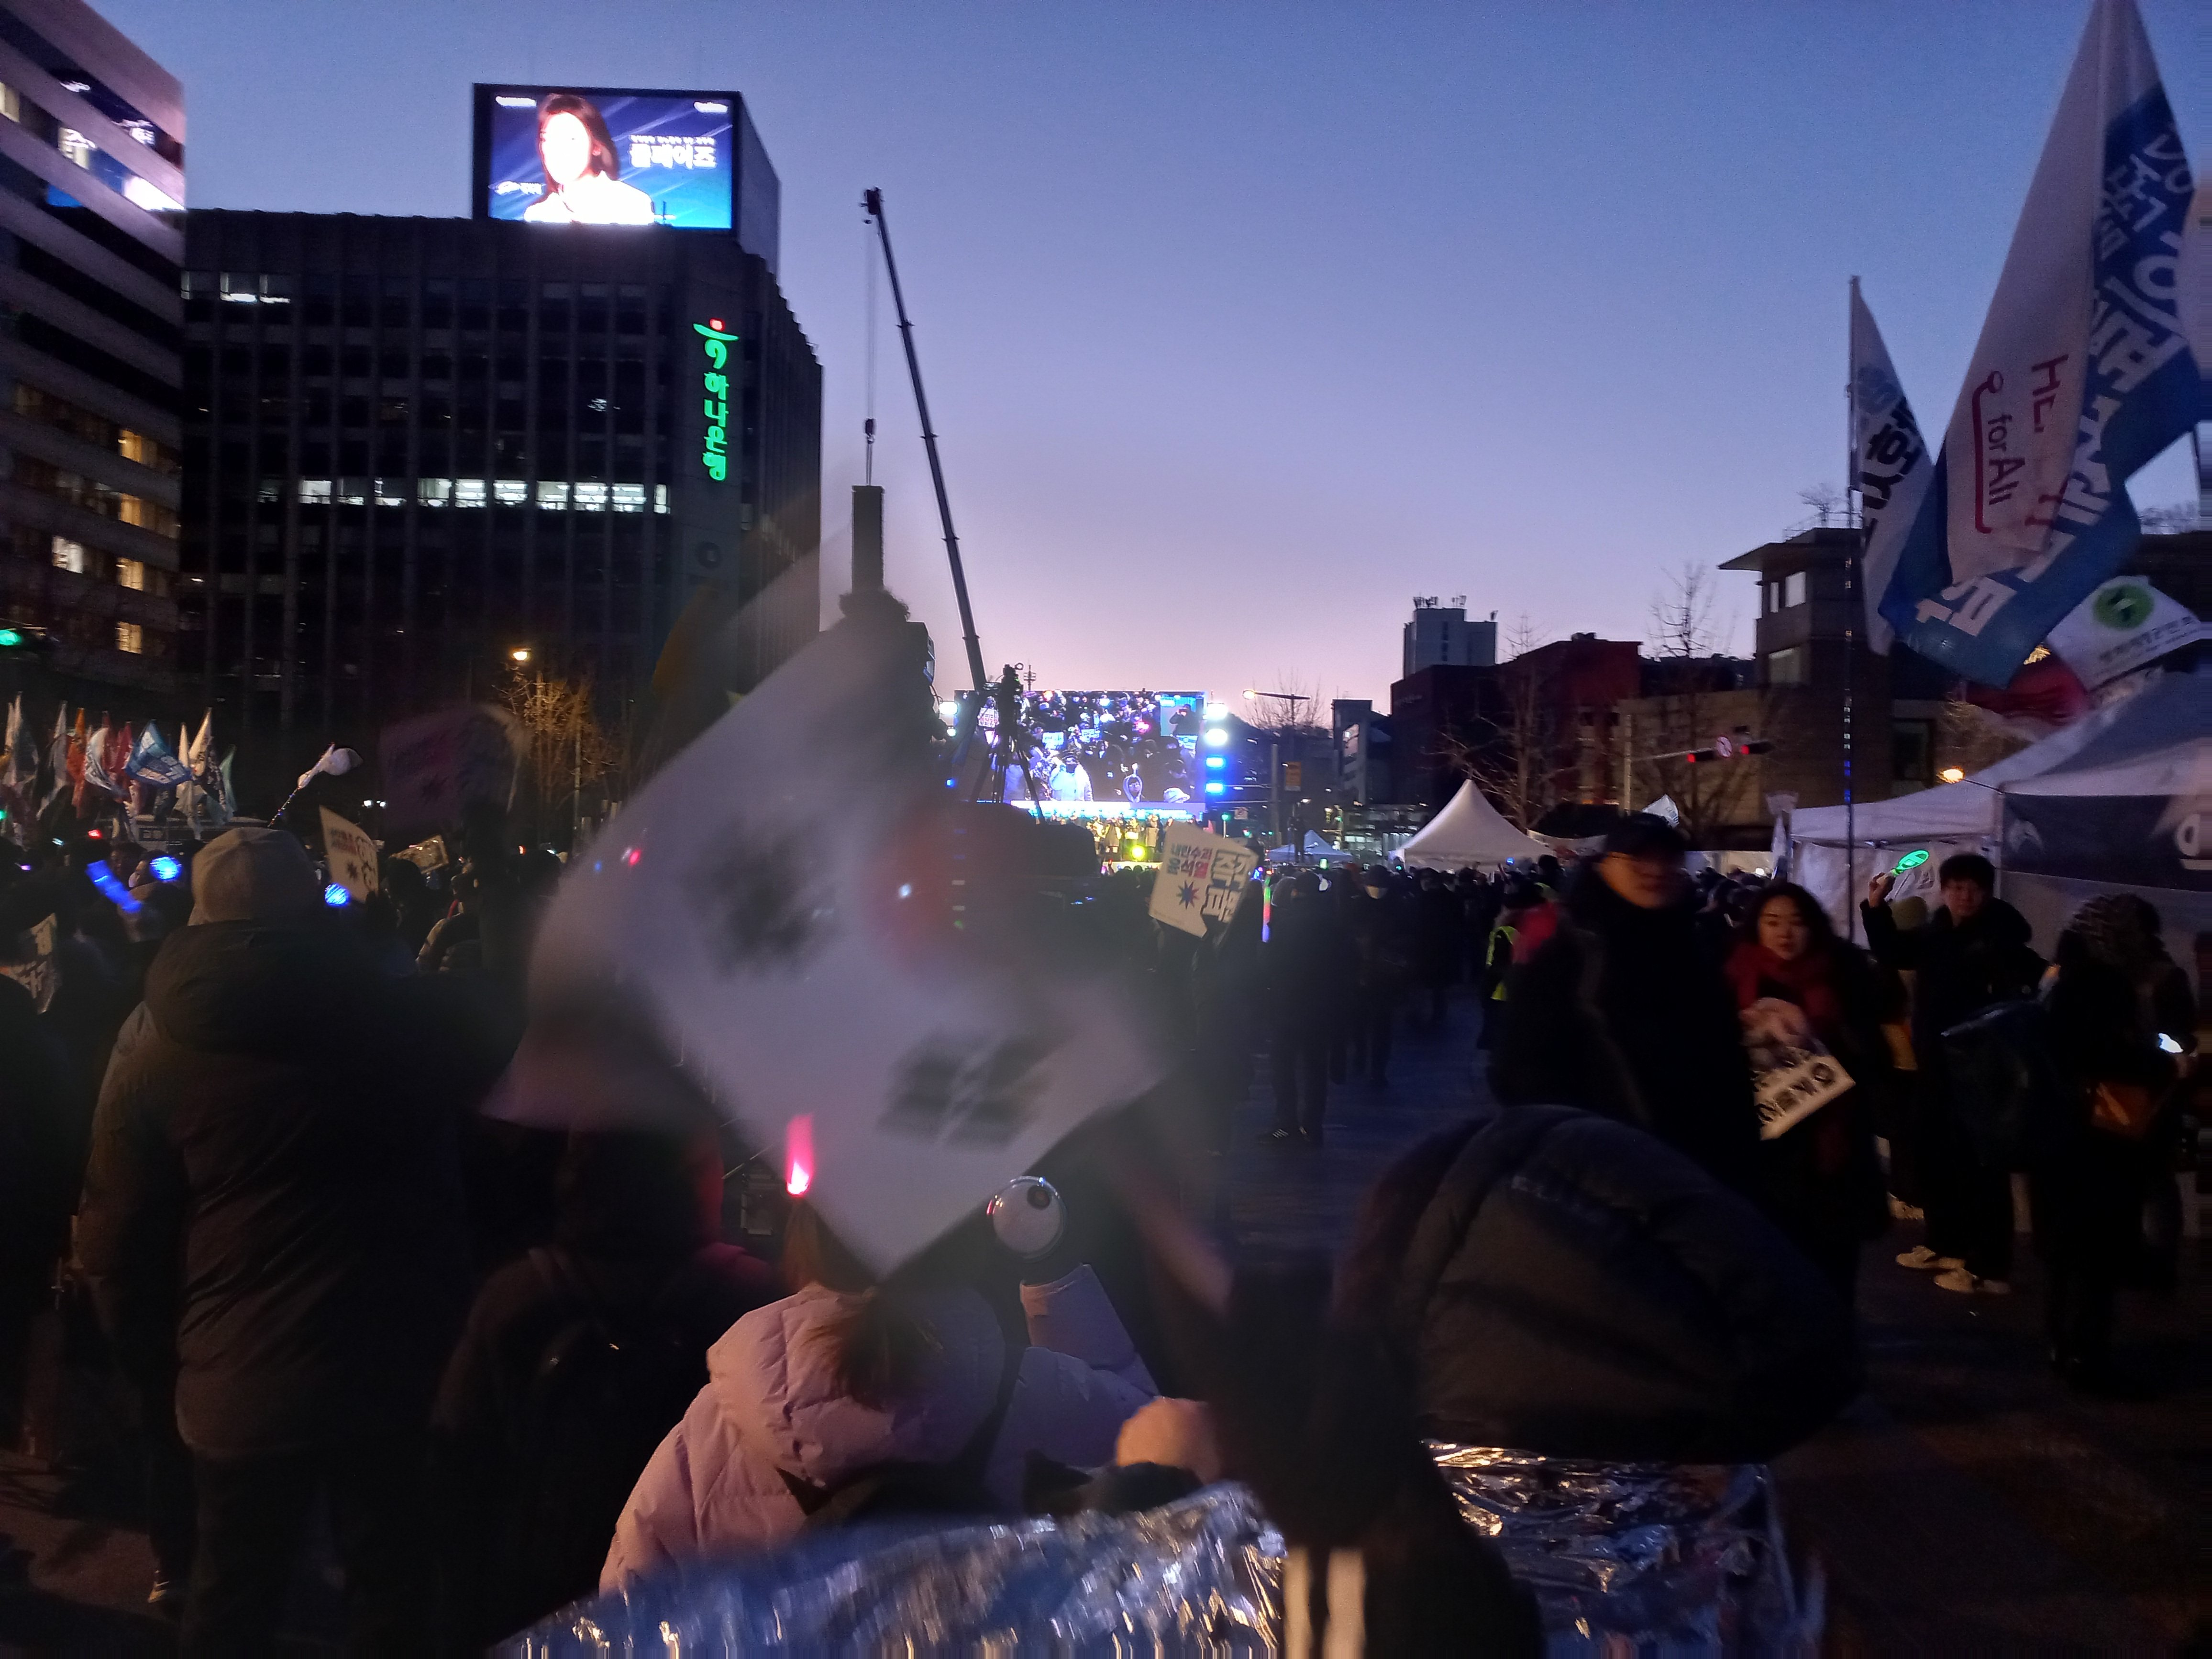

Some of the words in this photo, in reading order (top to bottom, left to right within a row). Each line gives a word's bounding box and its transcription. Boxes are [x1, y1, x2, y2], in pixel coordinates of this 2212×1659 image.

[703, 372, 730, 481] 하나은행
[1987, 414, 2012, 453] for
[1989, 458, 2025, 505] All
[1167, 857, 1209, 879] 윤석열
